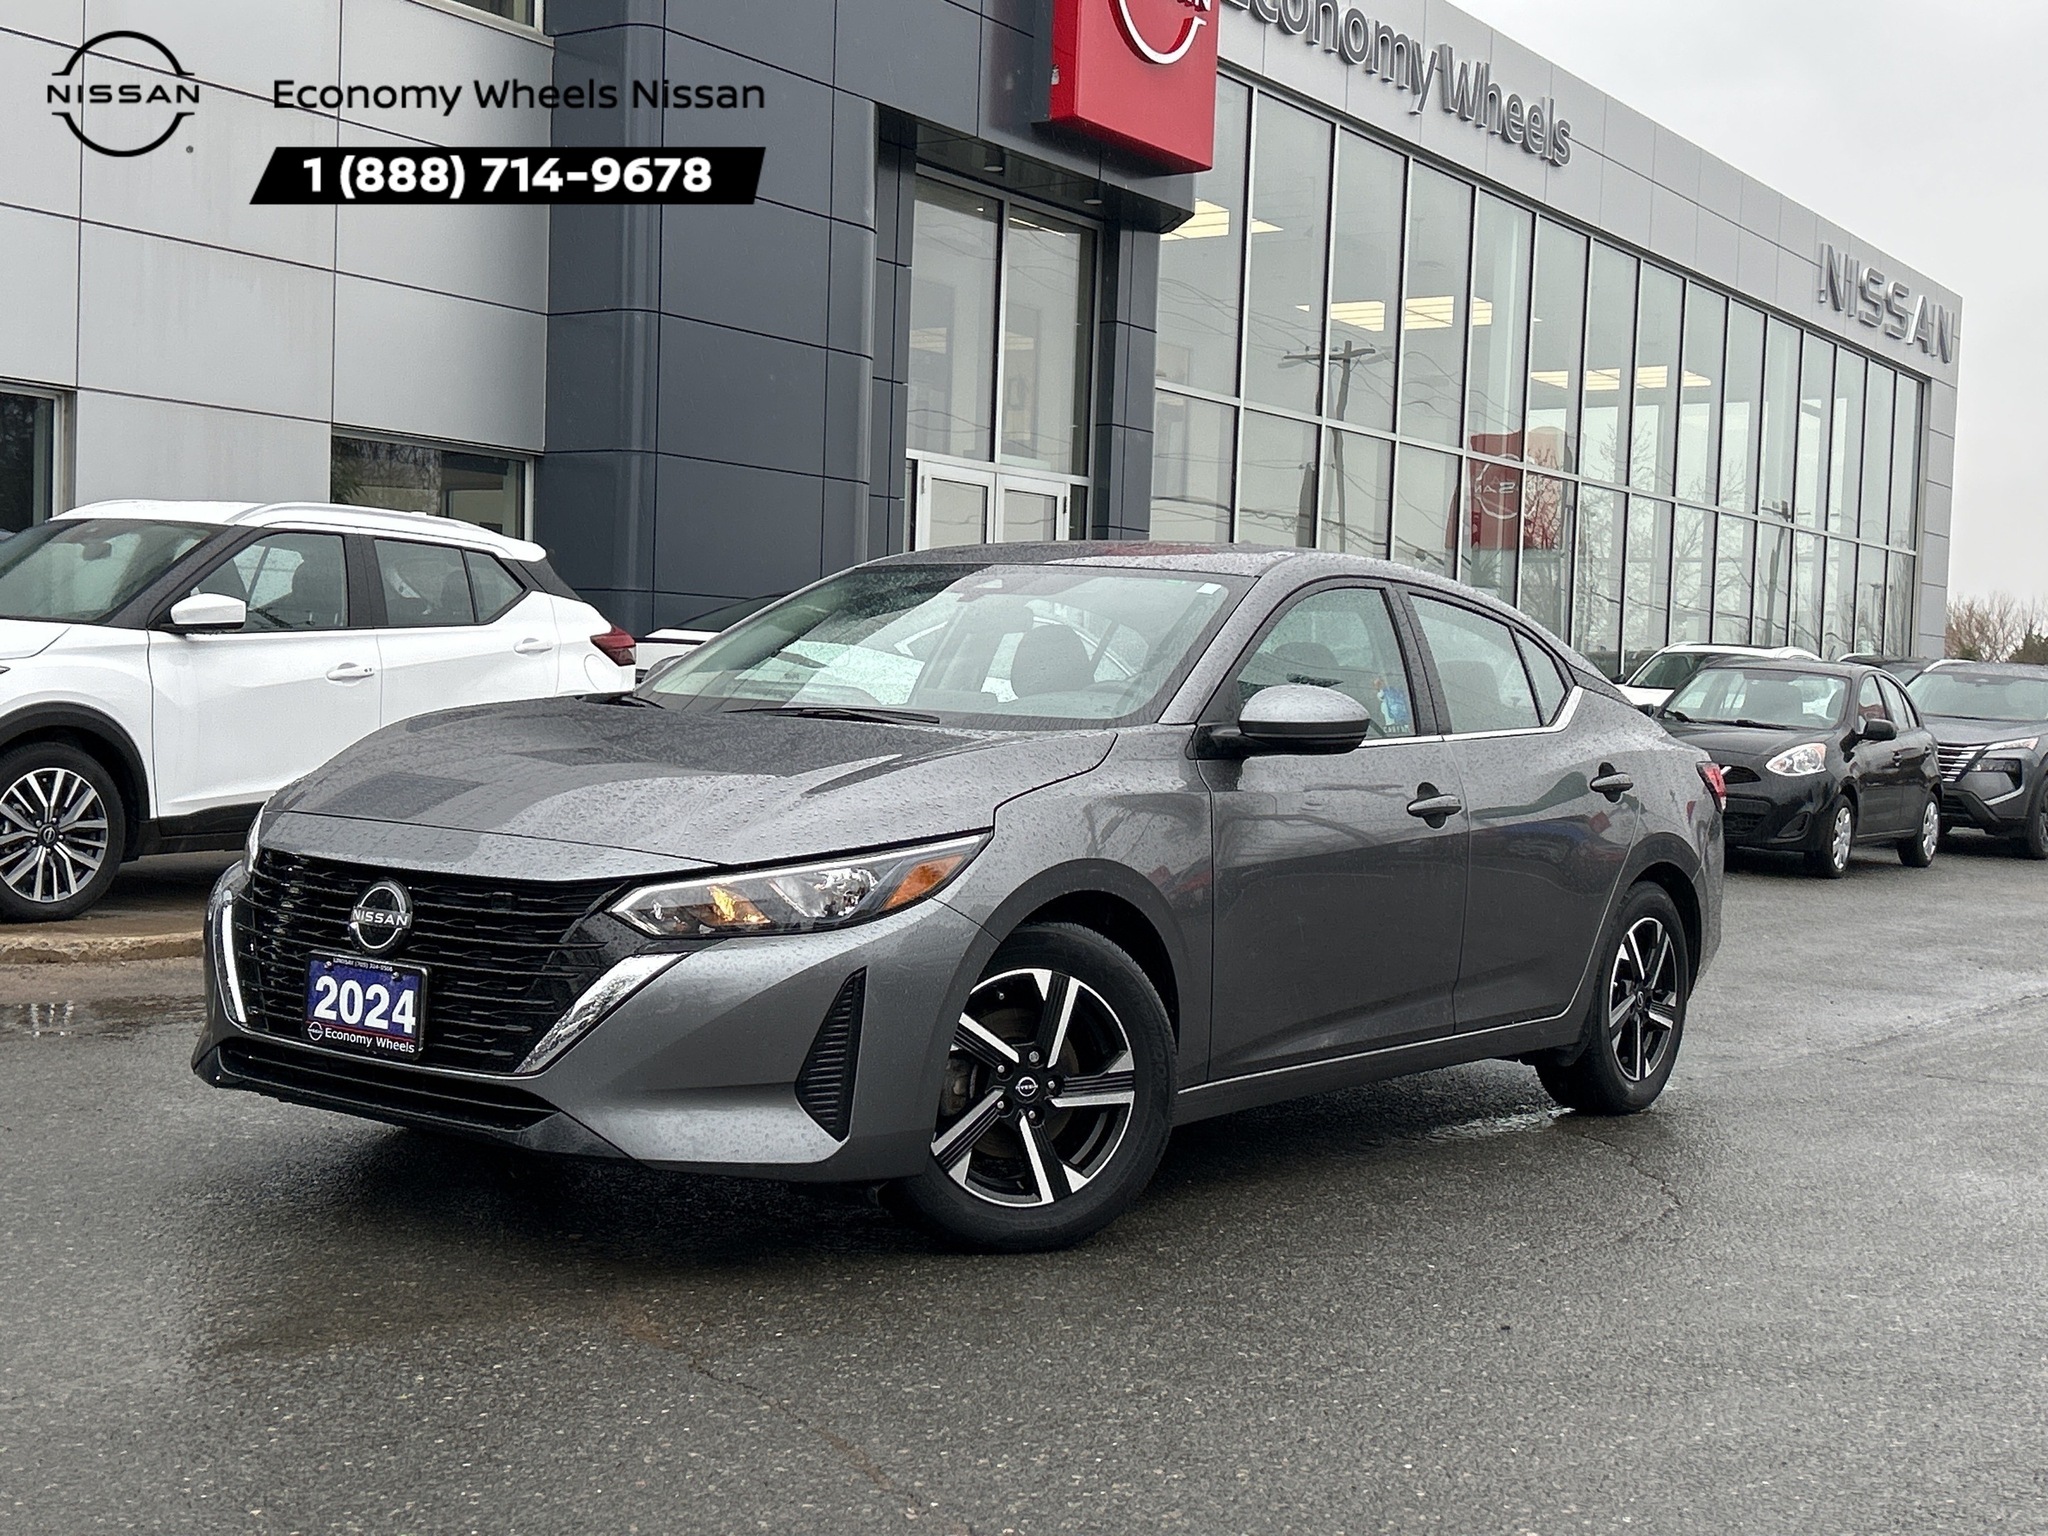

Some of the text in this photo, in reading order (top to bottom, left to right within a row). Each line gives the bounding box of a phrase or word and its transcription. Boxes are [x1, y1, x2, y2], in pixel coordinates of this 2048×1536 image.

[1220, 0, 1572, 168] onomy Wheels
[1818, 242, 1955, 364] NISSAN
[352, 908, 409, 927] NISSAN
[313, 974, 417, 1034] 2024
[324, 1027, 415, 1054] Economy Wheels
